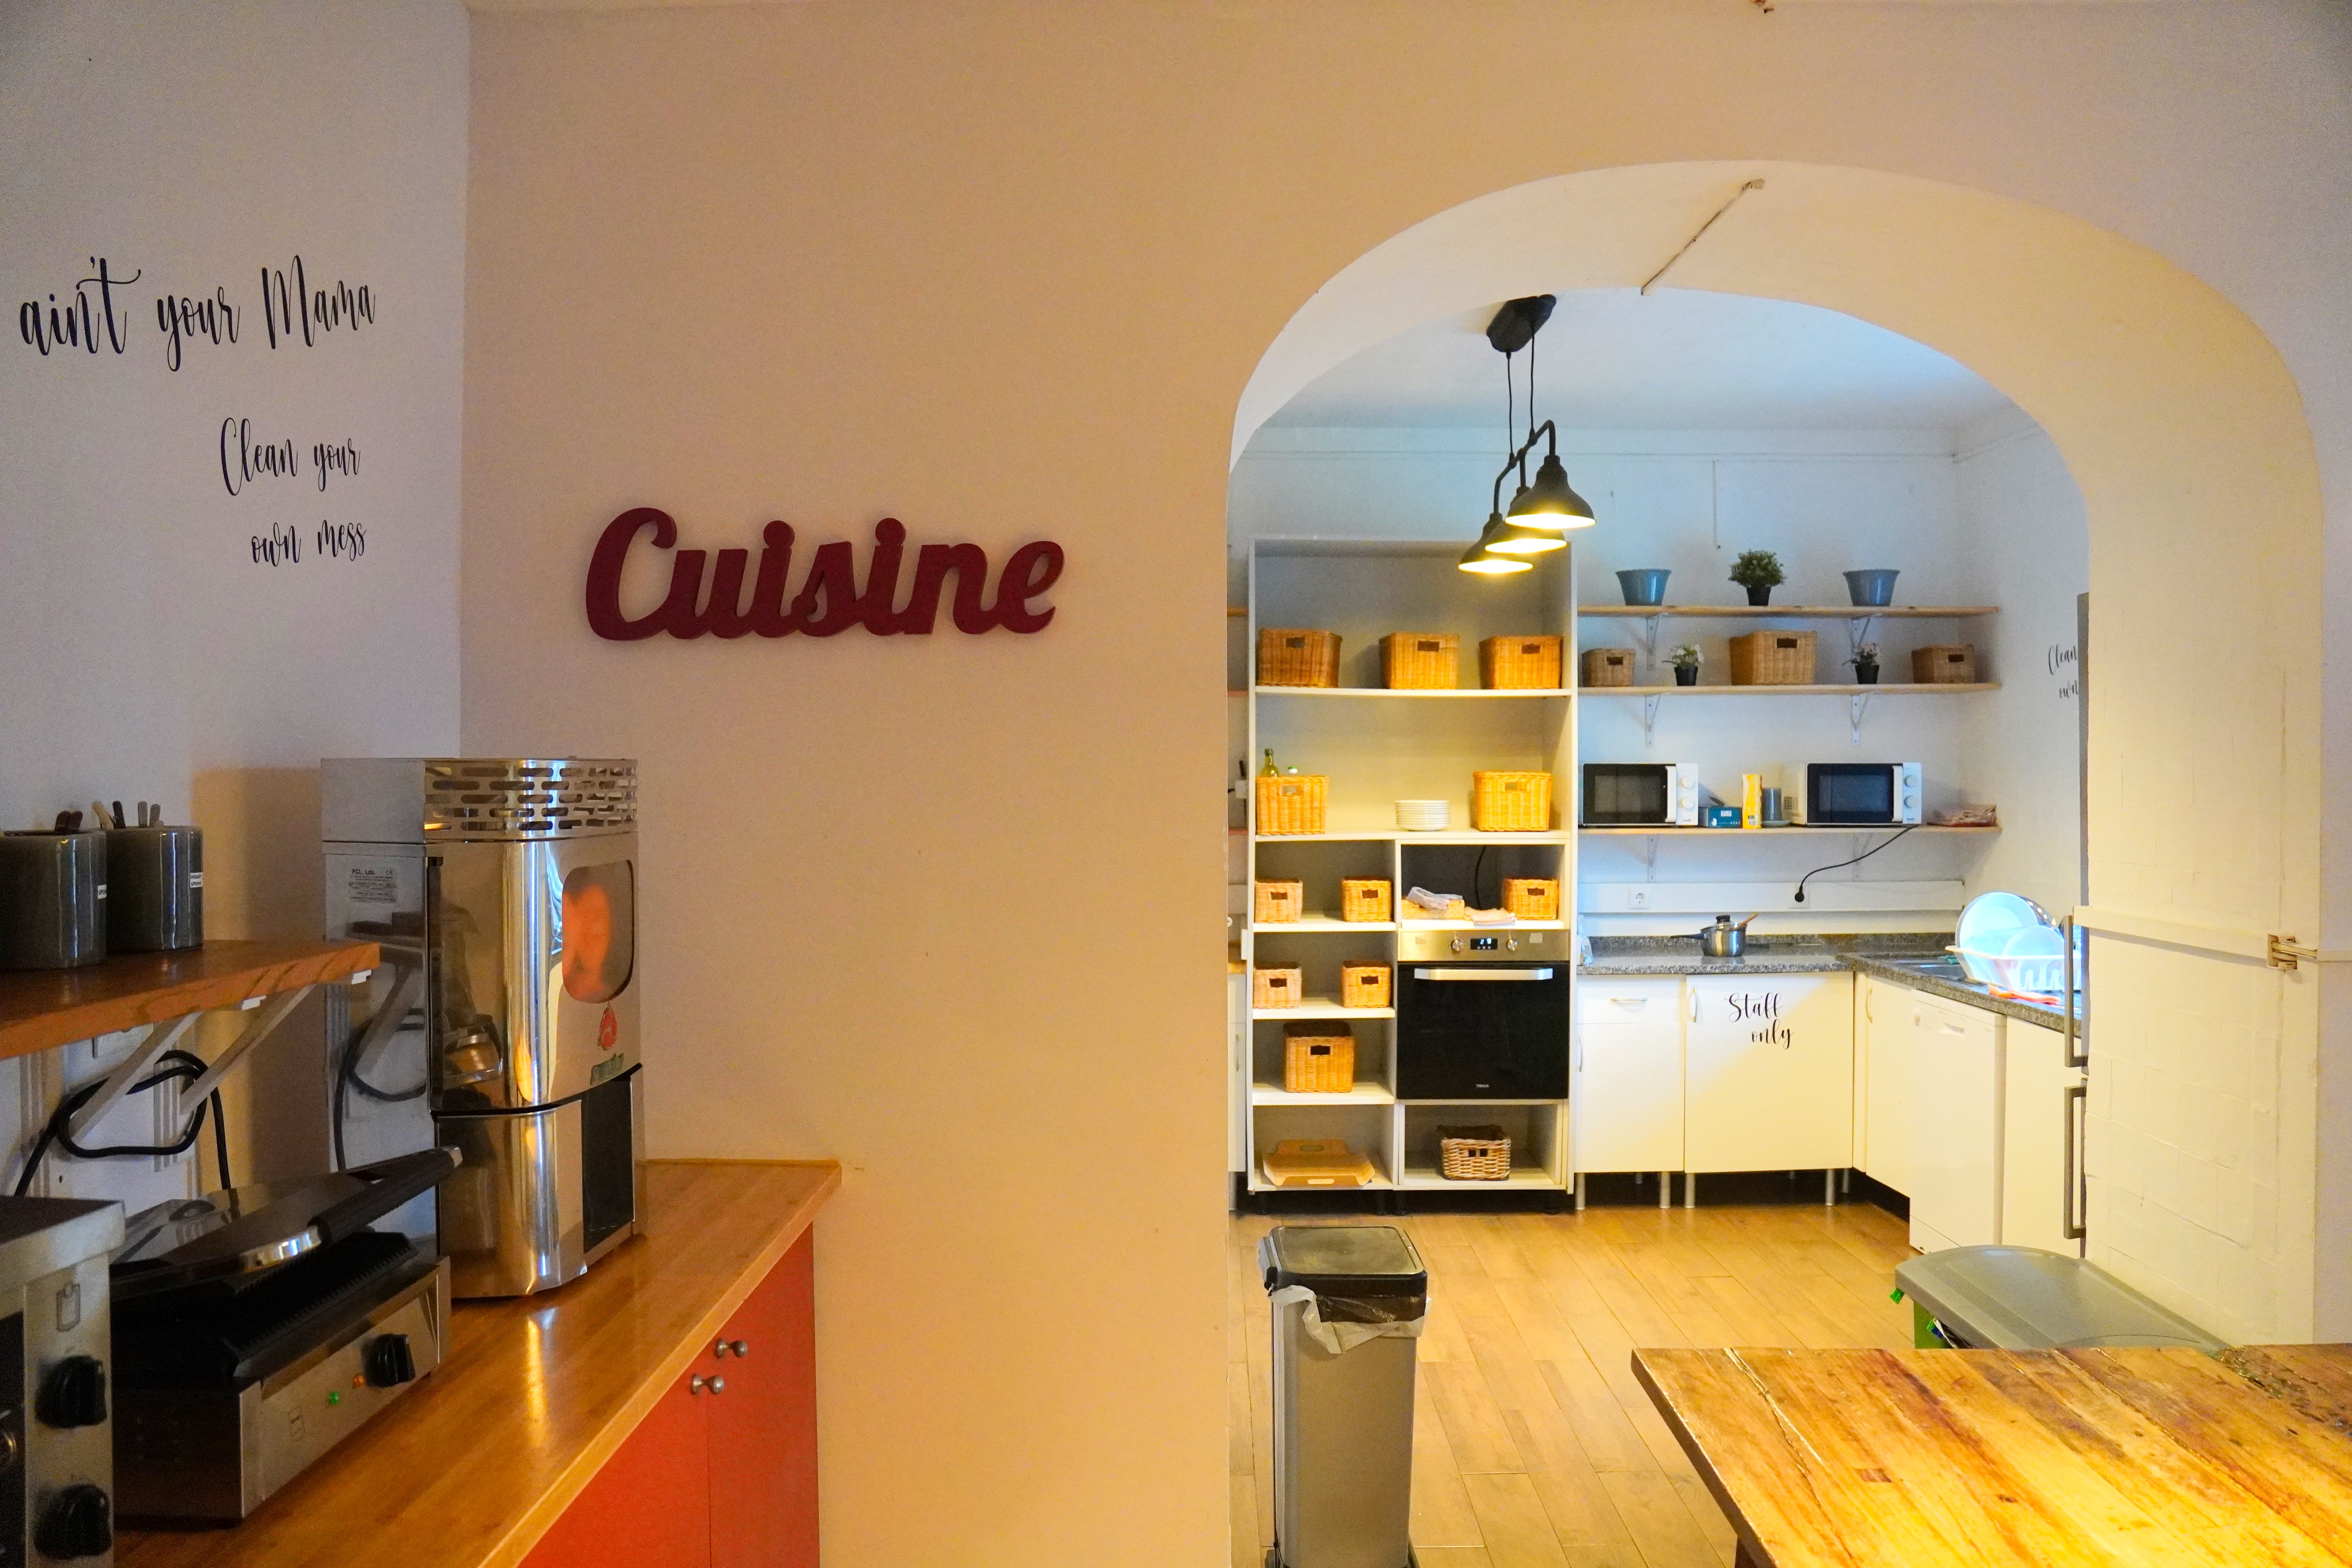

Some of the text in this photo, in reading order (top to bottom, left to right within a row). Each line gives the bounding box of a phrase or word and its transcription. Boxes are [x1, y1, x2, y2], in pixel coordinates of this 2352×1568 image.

[20, 255, 376, 372] ain't your Mama
[220, 417, 361, 496] Clean your
[251, 519, 367, 567] own mess
[585, 506, 1065, 642] Cuisine
[2048, 644, 2077, 675] Clean
[1724, 992, 1784, 1023] Staff
[1751, 1018, 1795, 1050] only
